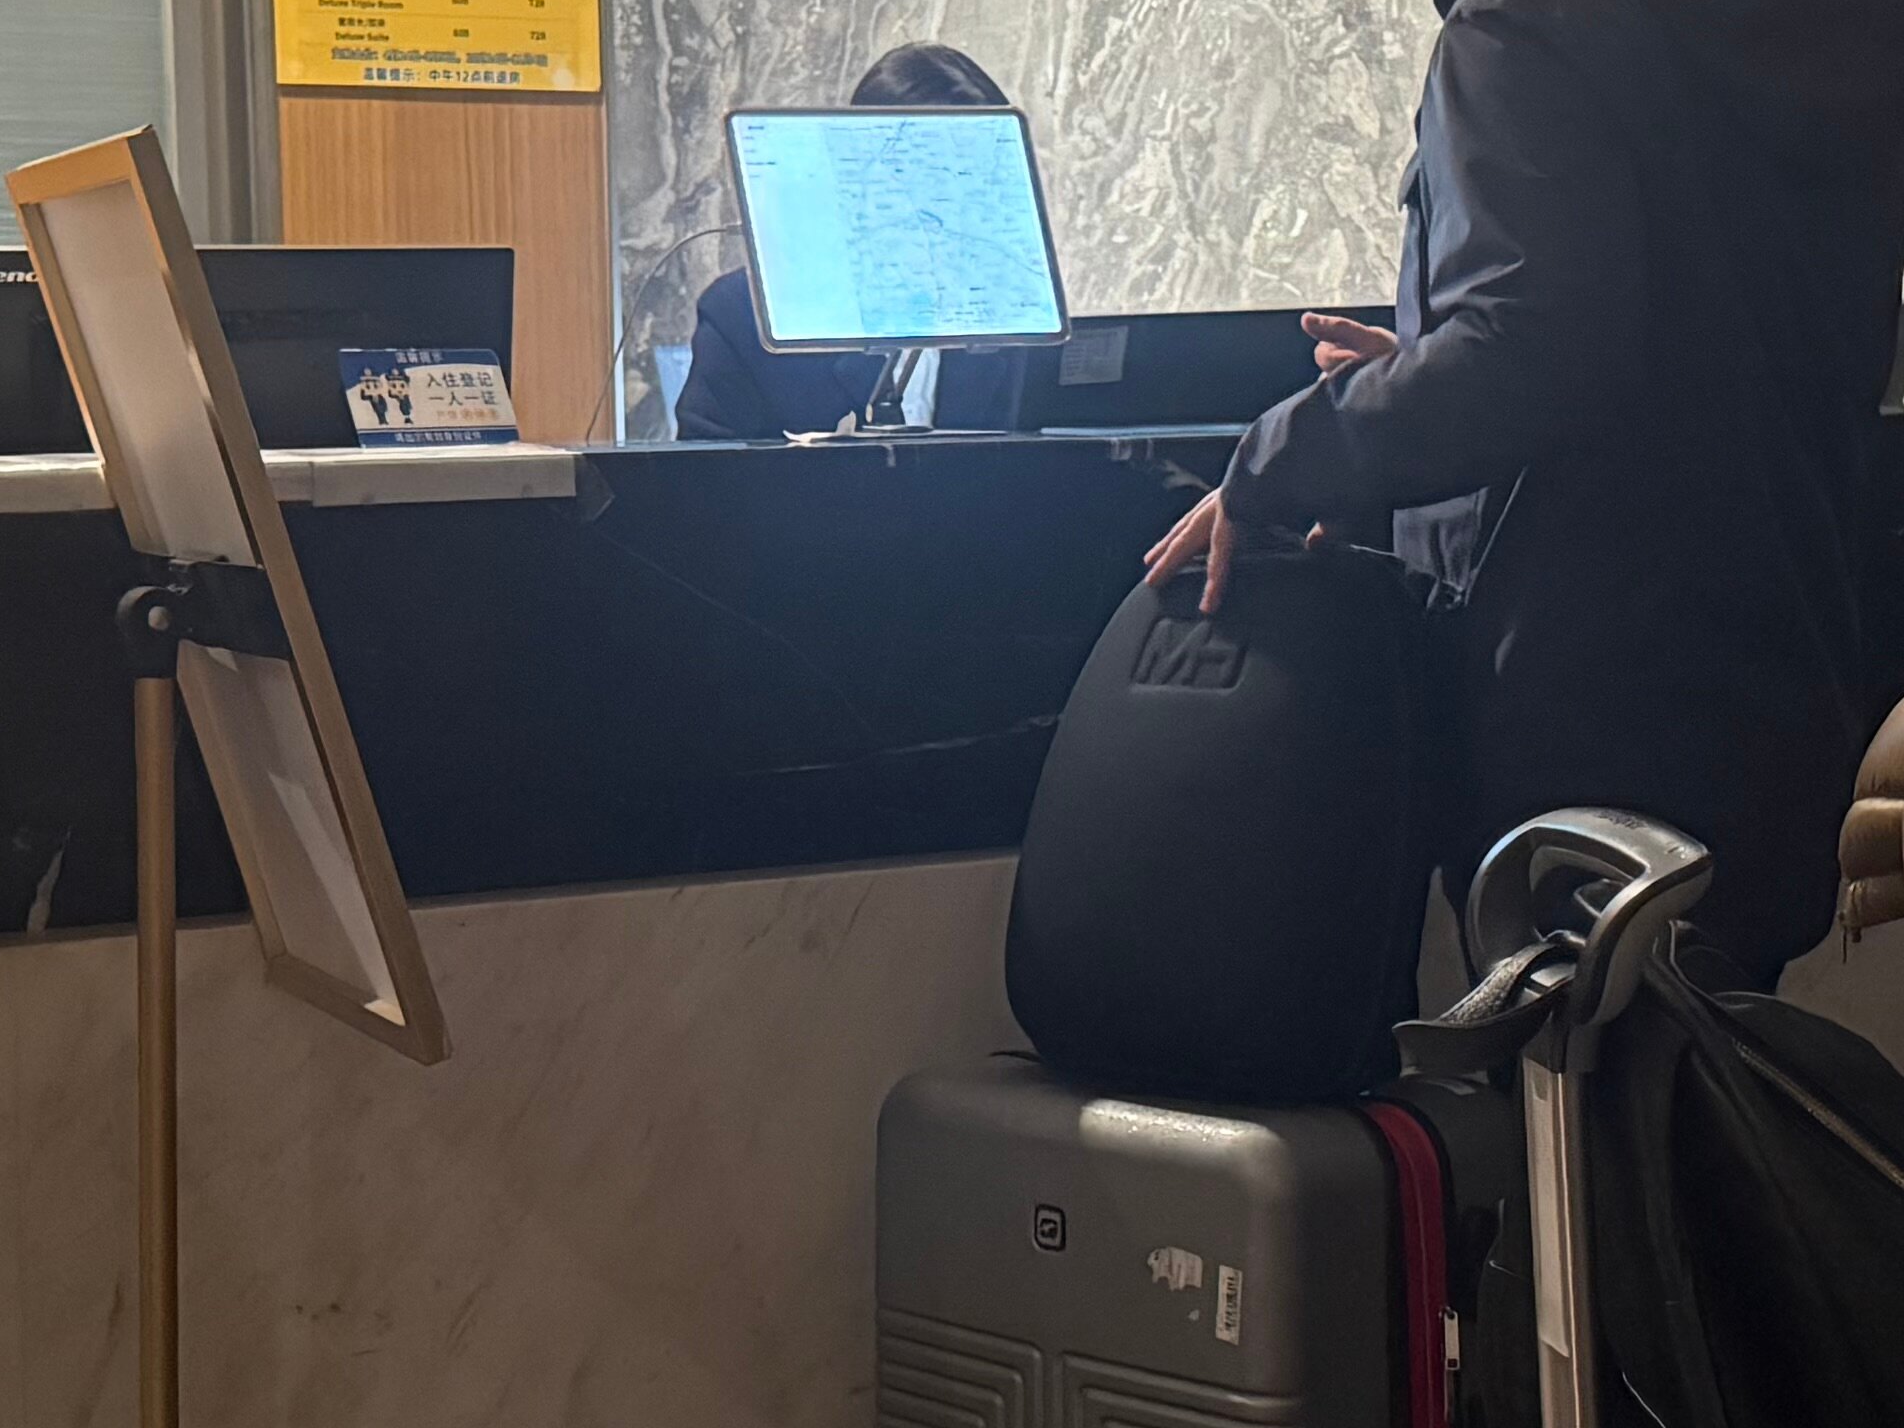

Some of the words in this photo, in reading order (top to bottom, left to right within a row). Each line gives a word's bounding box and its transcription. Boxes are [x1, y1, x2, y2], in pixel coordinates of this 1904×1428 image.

[427, 371, 494, 388] 入住登记
[428, 390, 499, 406] 一人一证
